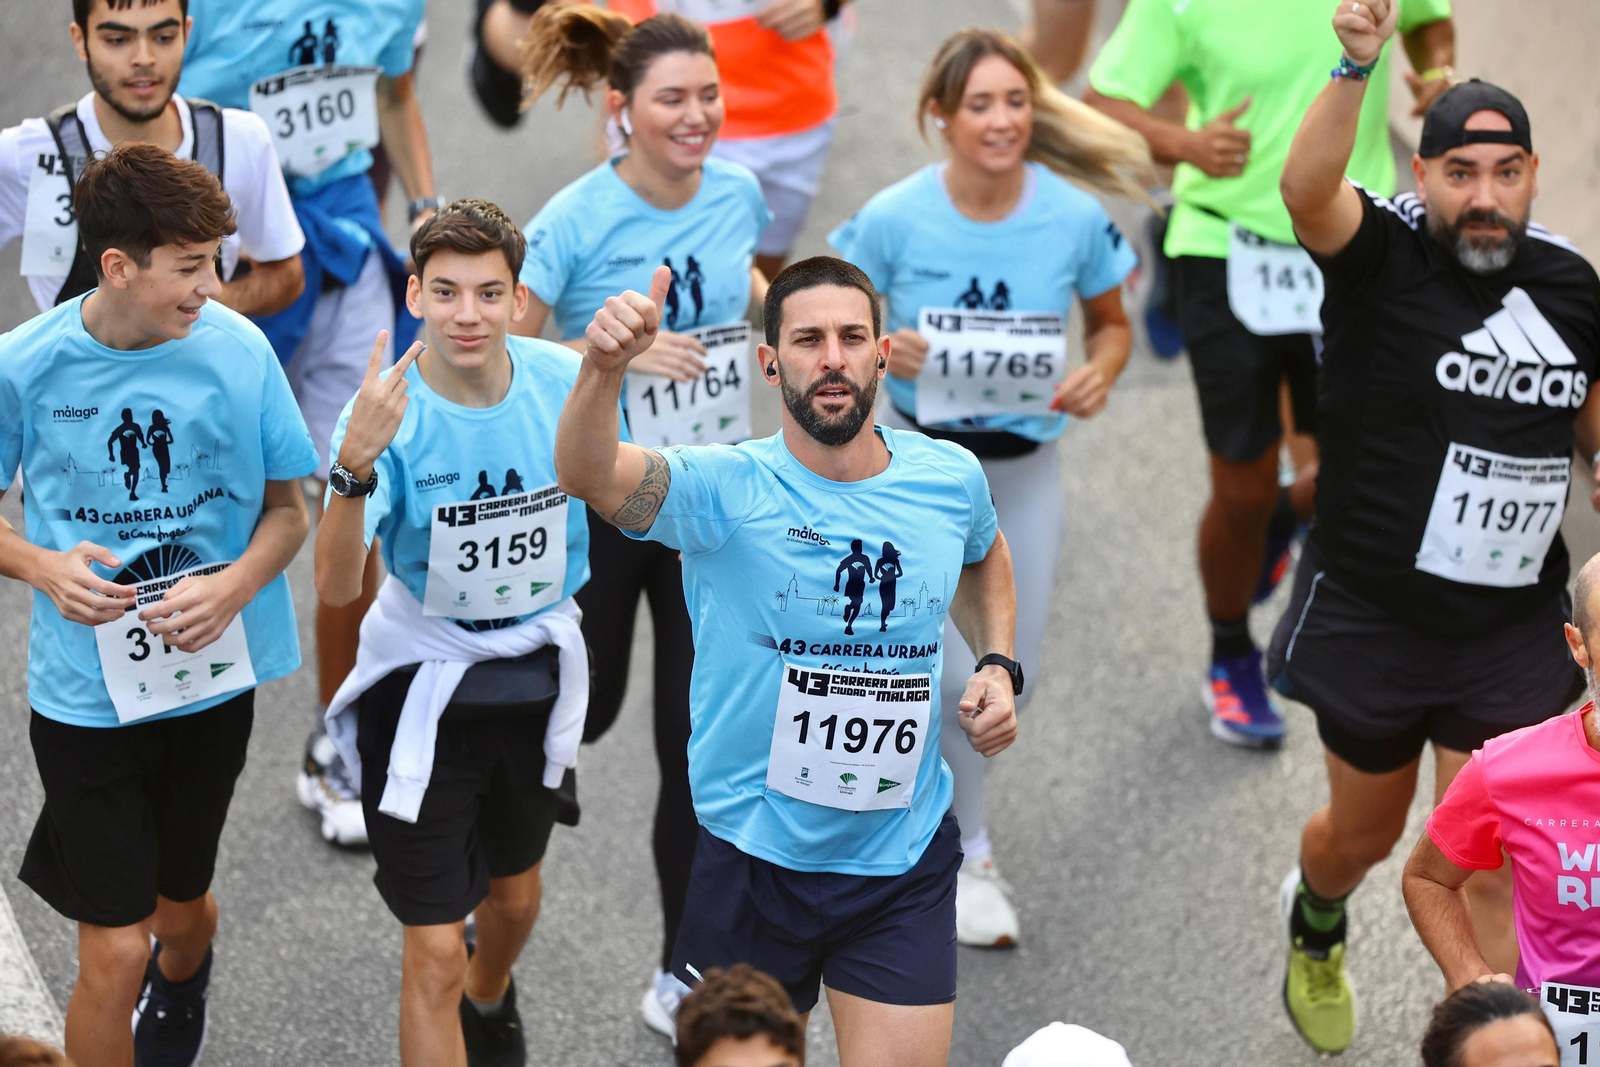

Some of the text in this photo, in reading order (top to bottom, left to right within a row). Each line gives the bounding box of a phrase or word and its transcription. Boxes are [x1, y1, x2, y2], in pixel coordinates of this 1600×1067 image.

[276, 89, 355, 139] 3160
[927, 314, 961, 331] 43
[933, 349, 1054, 379] 11765
[1435, 351, 1588, 409] adidas
[1453, 450, 1492, 478] 43
[75, 506, 99, 524] 43
[102, 506, 174, 524] CARRERA
[438, 486, 562, 527] 43 CARRERA URBAN
[478, 509, 510, 521] CIUDAD
[1452, 491, 1557, 534] 11977
[457, 526, 547, 573] 3159
[779, 638, 938, 659] 43 CARRERA URBANA
[787, 667, 930, 697] 43 CARRERA URBANA
[829, 686, 867, 697] CIUDAD
[793, 710, 918, 755] 11976
[1524, 818, 1600, 828] CARRERA
[1546, 985, 1590, 1017] 43
